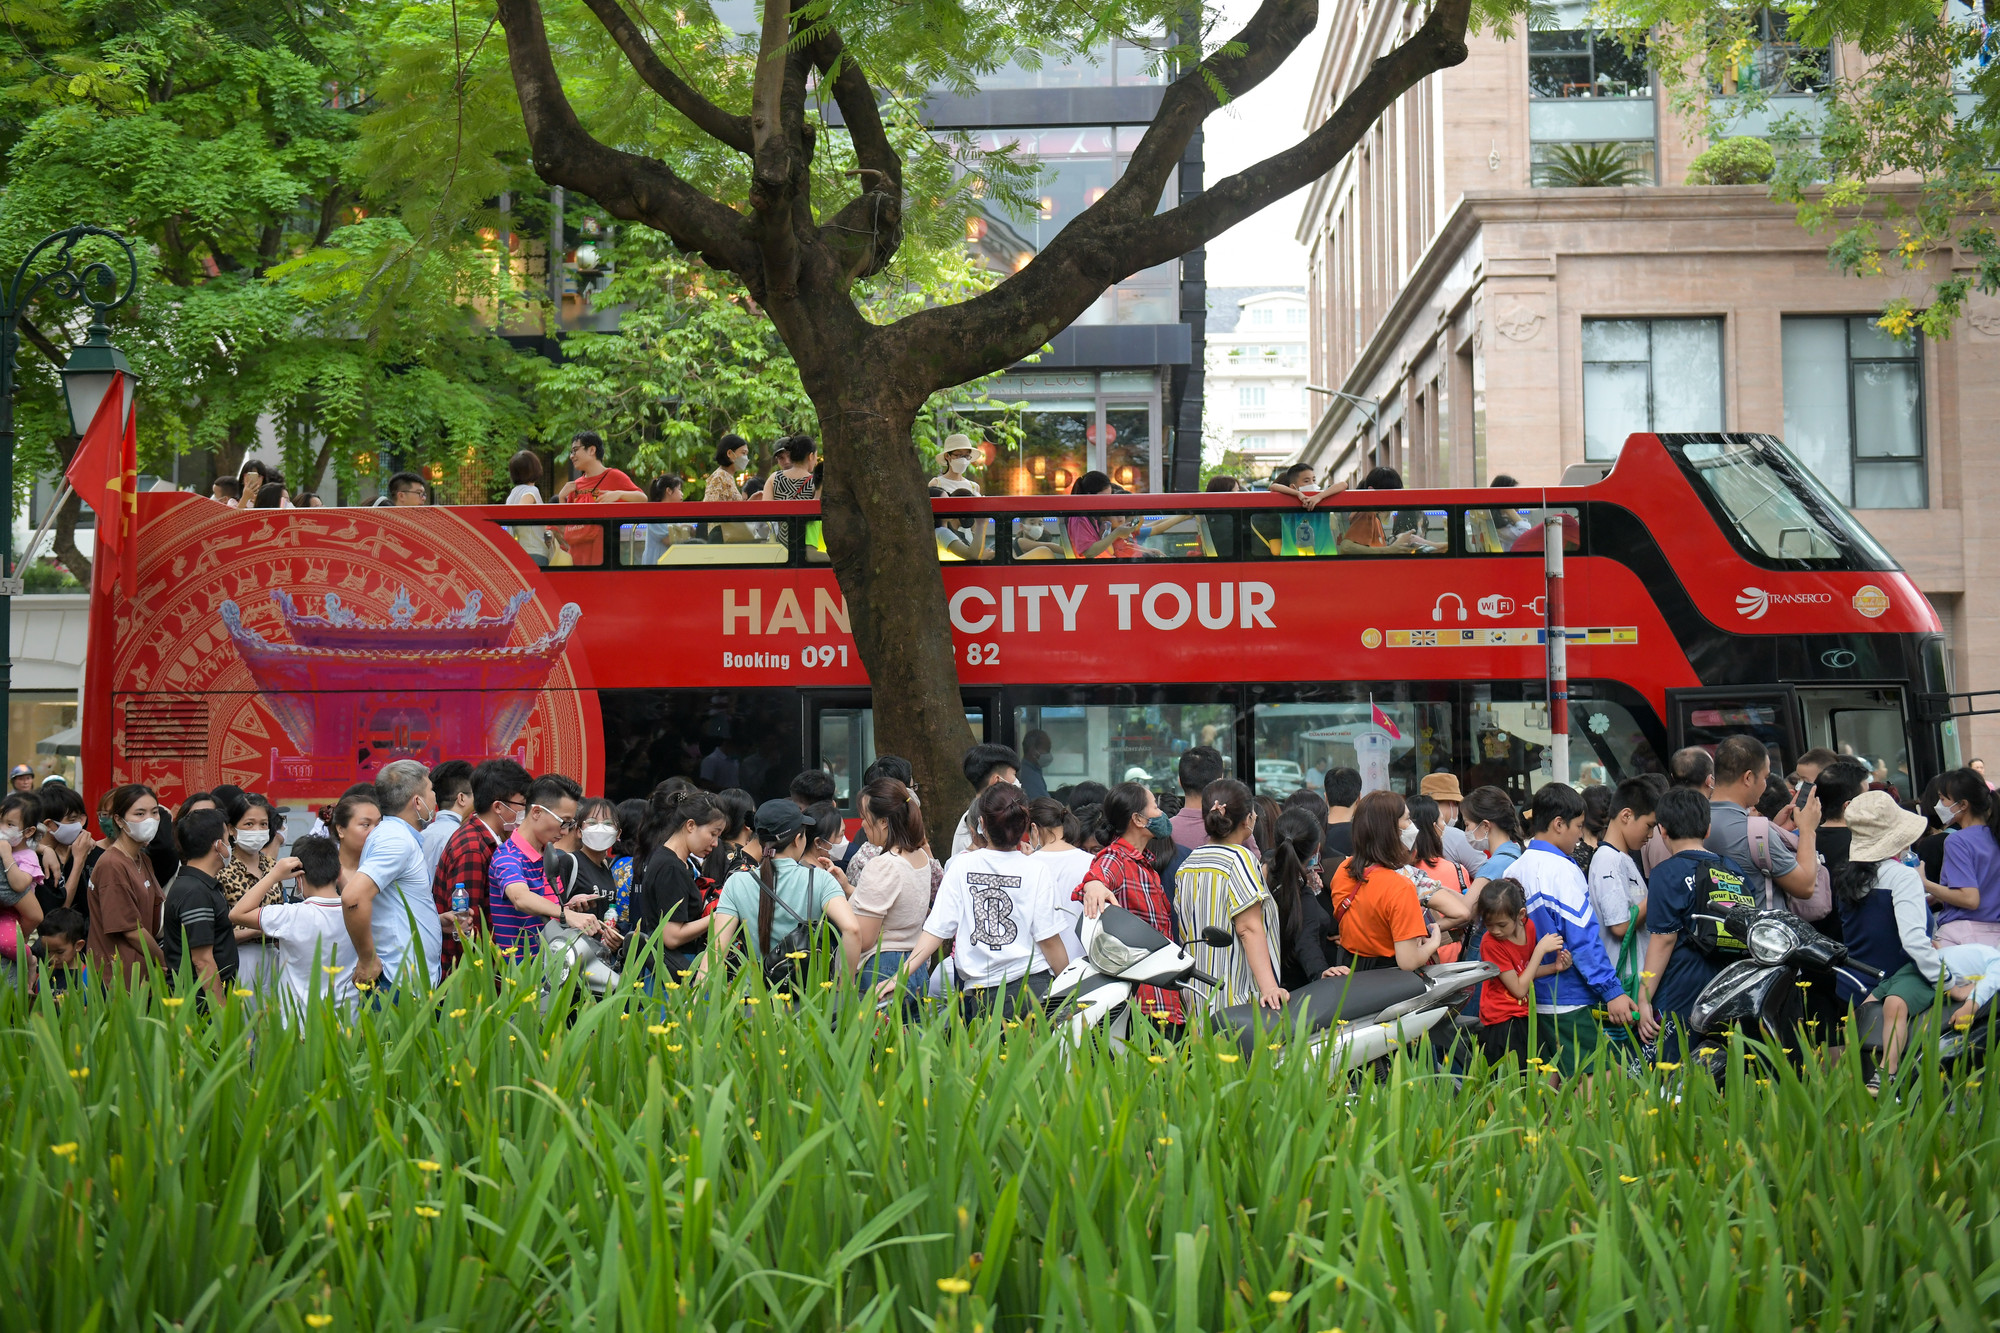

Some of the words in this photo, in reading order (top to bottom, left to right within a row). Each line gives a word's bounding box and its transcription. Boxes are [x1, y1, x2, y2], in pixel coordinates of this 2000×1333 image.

[723, 587, 852, 635] HAN
[949, 585, 1089, 634] CITY
[1108, 581, 1277, 631] TOUR
[1768, 593, 1832, 604] TRANSERCO
[723, 651, 790, 670] Booking
[801, 645, 848, 668] 091
[966, 643, 1000, 665] 82
